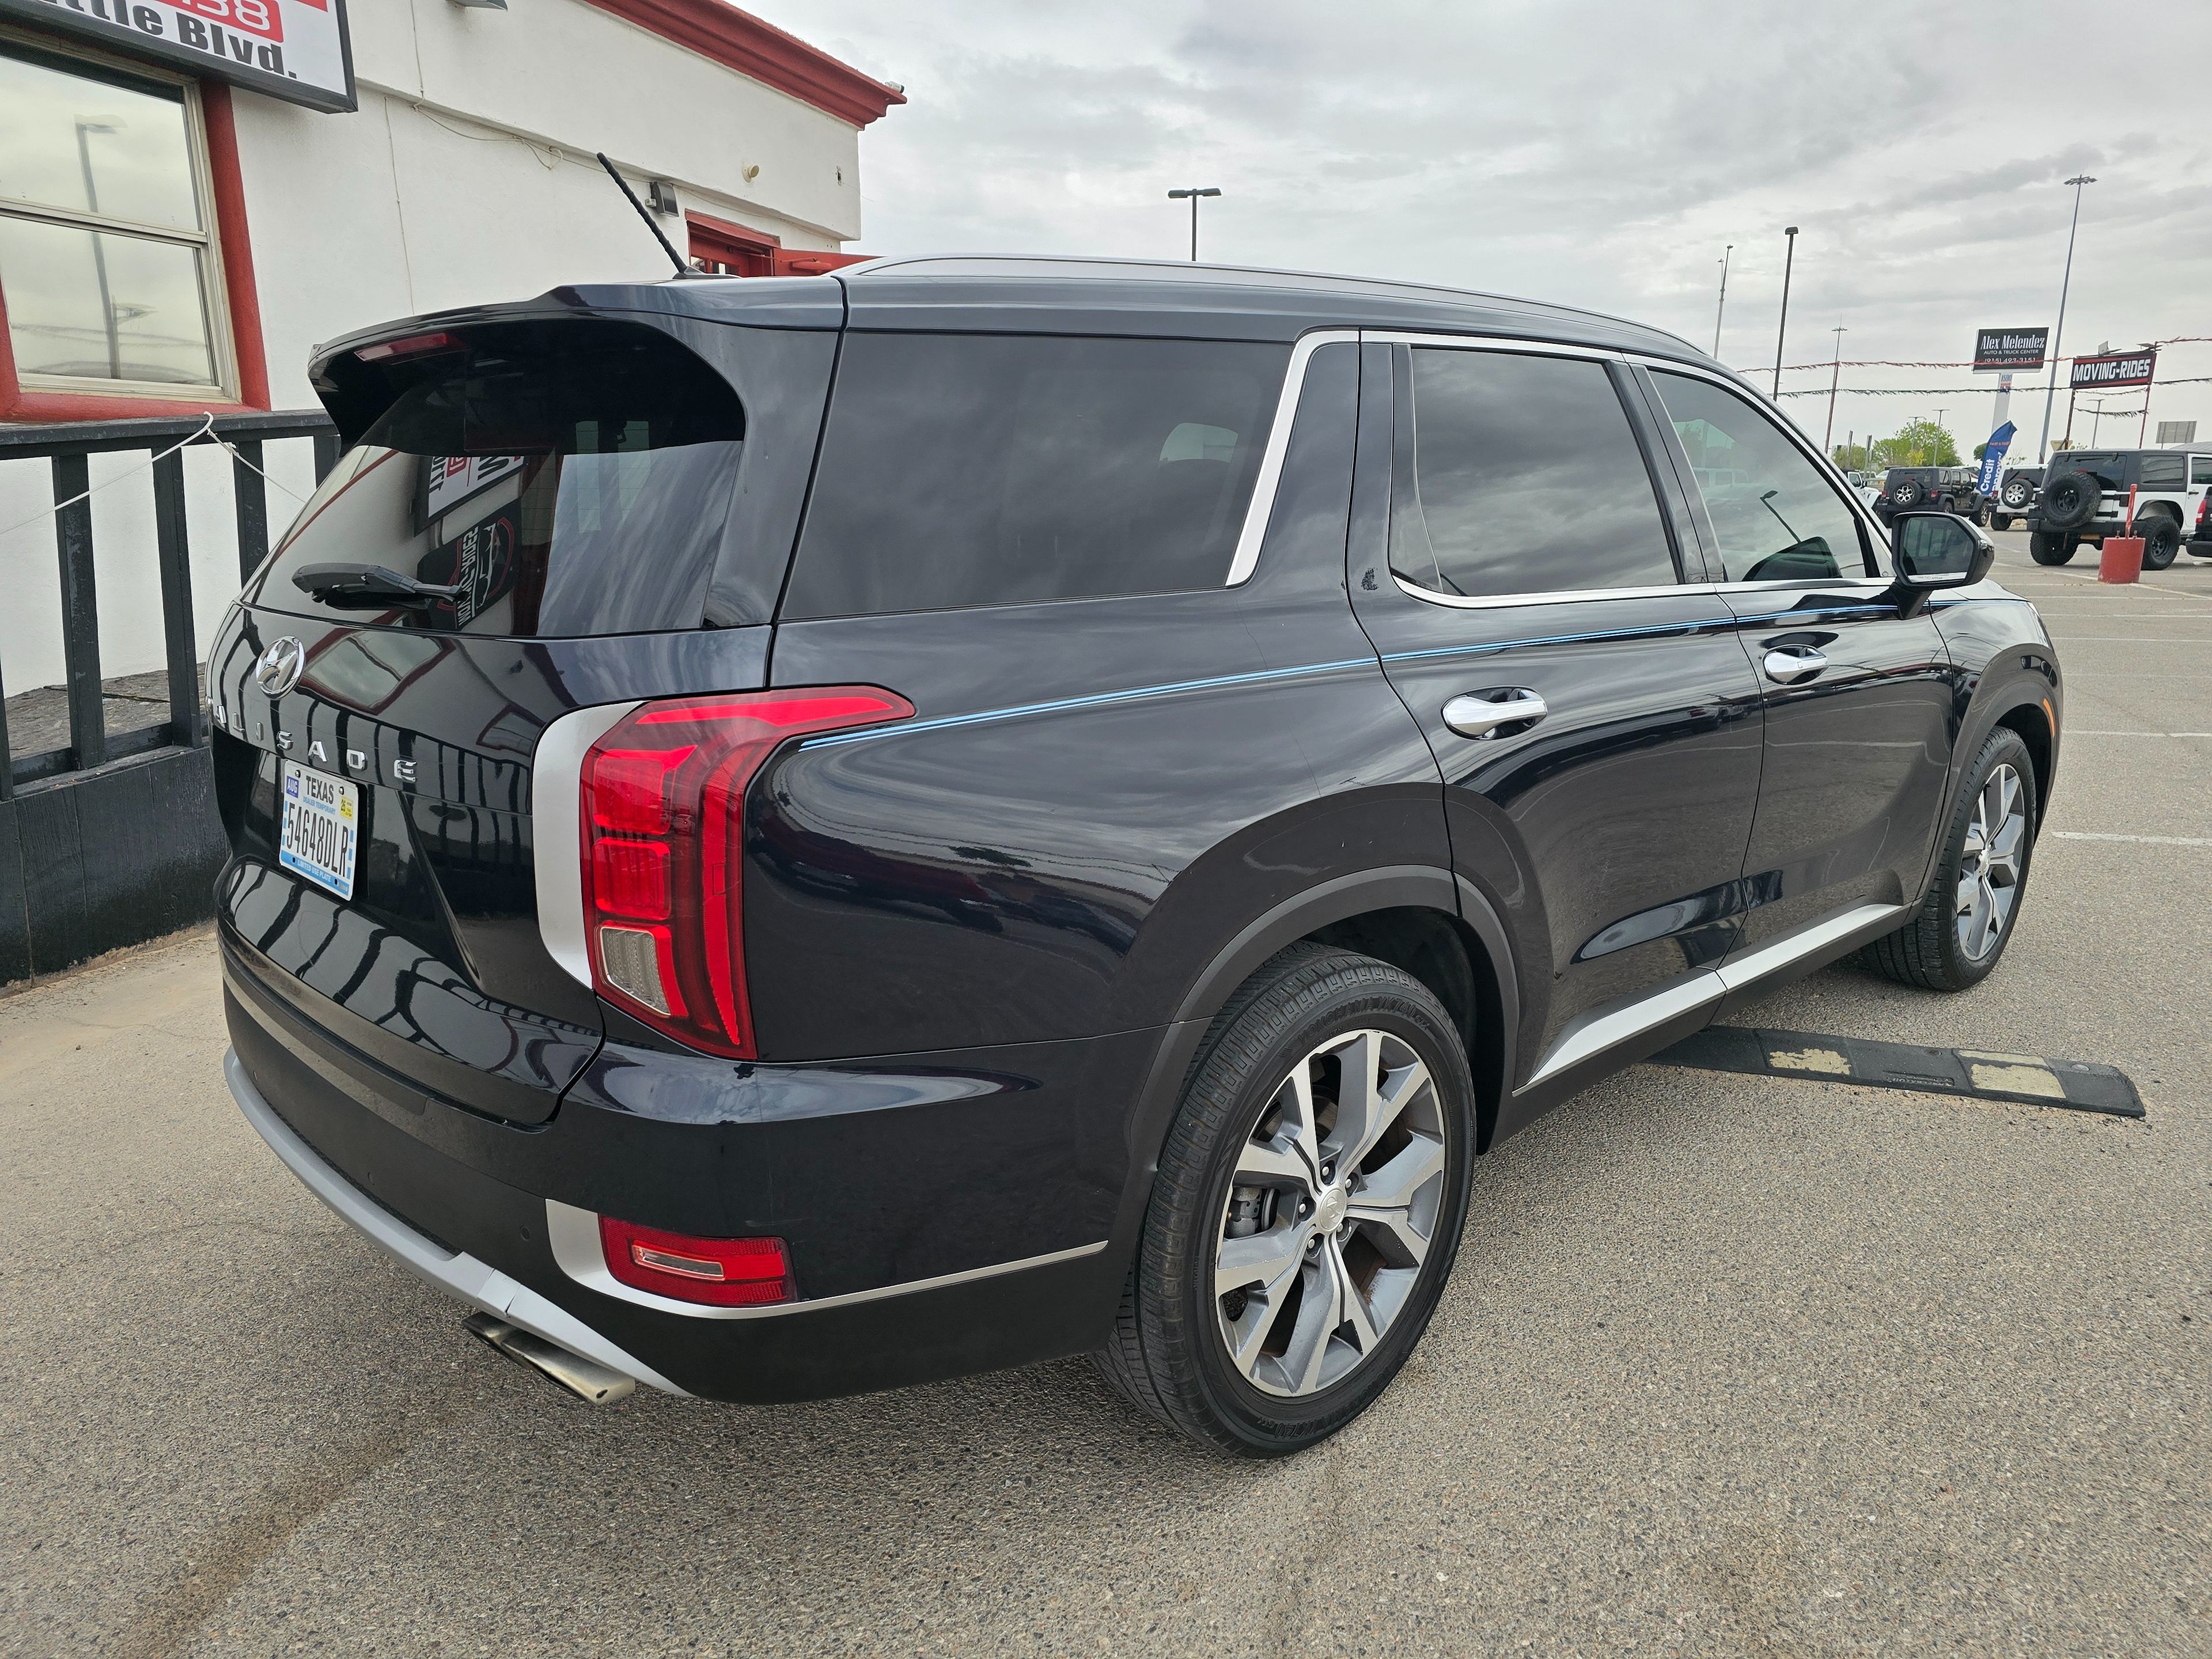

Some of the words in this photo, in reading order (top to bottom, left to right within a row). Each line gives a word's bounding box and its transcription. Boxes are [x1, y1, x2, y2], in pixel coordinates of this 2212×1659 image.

[176, 12, 297, 79] Blvd.
[1980, 335, 2000, 350] Alex
[2001, 334, 2046, 350] Melendez
[2073, 359, 2151, 382] MOVING-RIDES
[1980, 459, 1995, 492] Credit
[287, 778, 298, 794] AUG
[306, 775, 334, 805] TEXAS
[286, 802, 349, 877] 54648DLR
[297, 859, 312, 872] LIMITED
[311, 865, 320, 875] USE
[319, 870, 331, 882] PLATE
